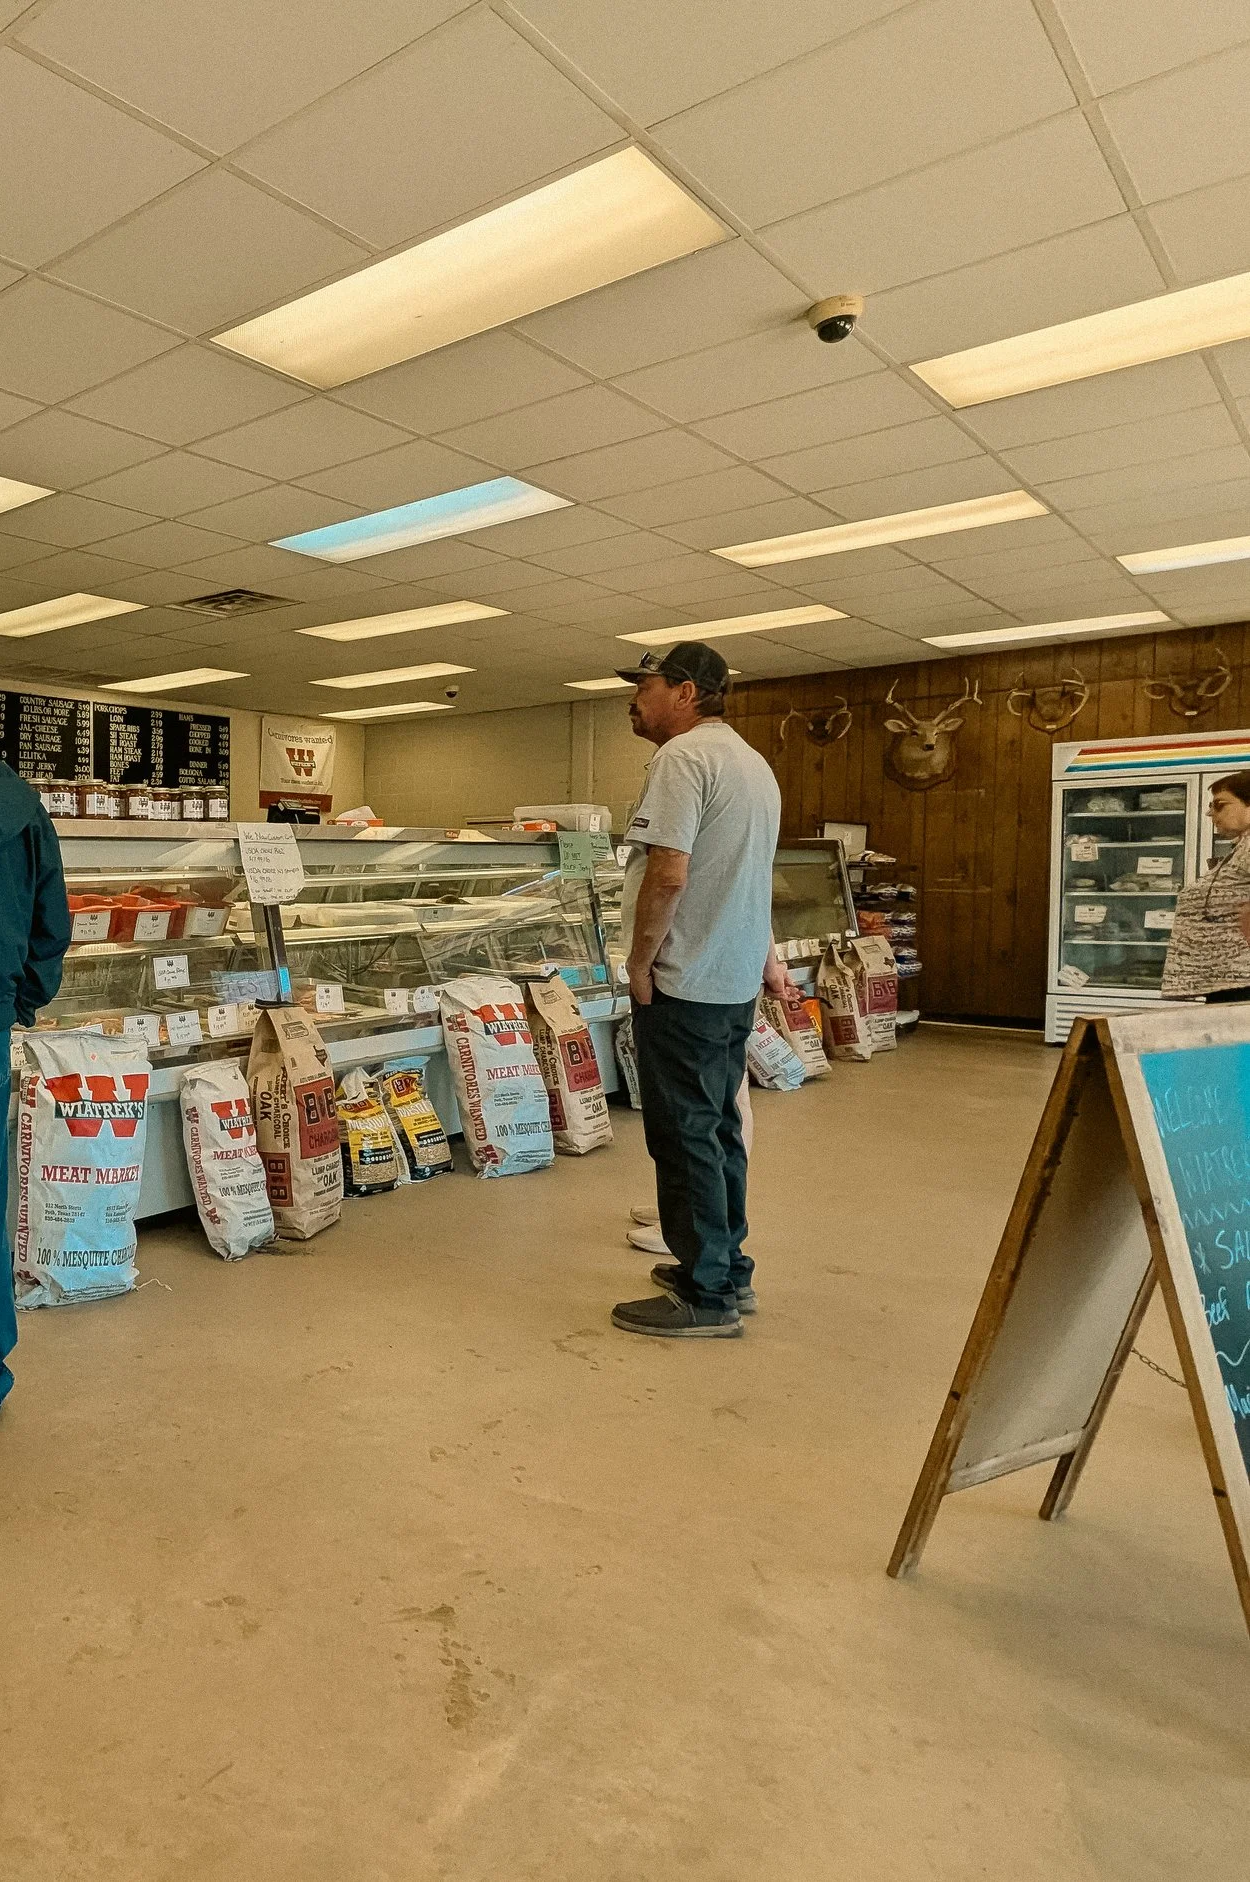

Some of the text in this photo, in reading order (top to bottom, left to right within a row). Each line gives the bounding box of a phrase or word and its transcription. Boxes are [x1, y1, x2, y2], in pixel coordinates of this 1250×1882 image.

[20, 696, 75, 709] COUNTRY SAUSAGE
[53, 709, 70, 717] MORE
[110, 714, 124, 722] LOIN
[20, 714, 68, 726] FRESH SAUSAGE
[19, 724, 59, 734] JAL-CHEESE
[20, 733, 62, 744] DRY SAUSAGE
[119, 732, 138, 740] STEAK
[19, 742, 63, 752] PAN SAUSAGE
[119, 739, 137, 748] ROAST
[110, 746, 142, 756] HAM STEAK
[110, 753, 142, 763] HAM ROAST
[19, 761, 57, 772] BEEF JERKY
[110, 761, 130, 769] BONES
[19, 771, 54, 780] BEEF HEAD
[179, 768, 203, 777] BOLOGNA
[456, 1037, 480, 1100] CARNIVORES
[486, 1065, 520, 1081] MEAT
[58, 1101, 144, 1119] WIATREK'S
[259, 1091, 272, 1121] OAK
[468, 1100, 488, 1141] WANTED
[41, 1165, 140, 1184] MEAT MARKET
[36, 1248, 109, 1270] 100 MESQUITE
